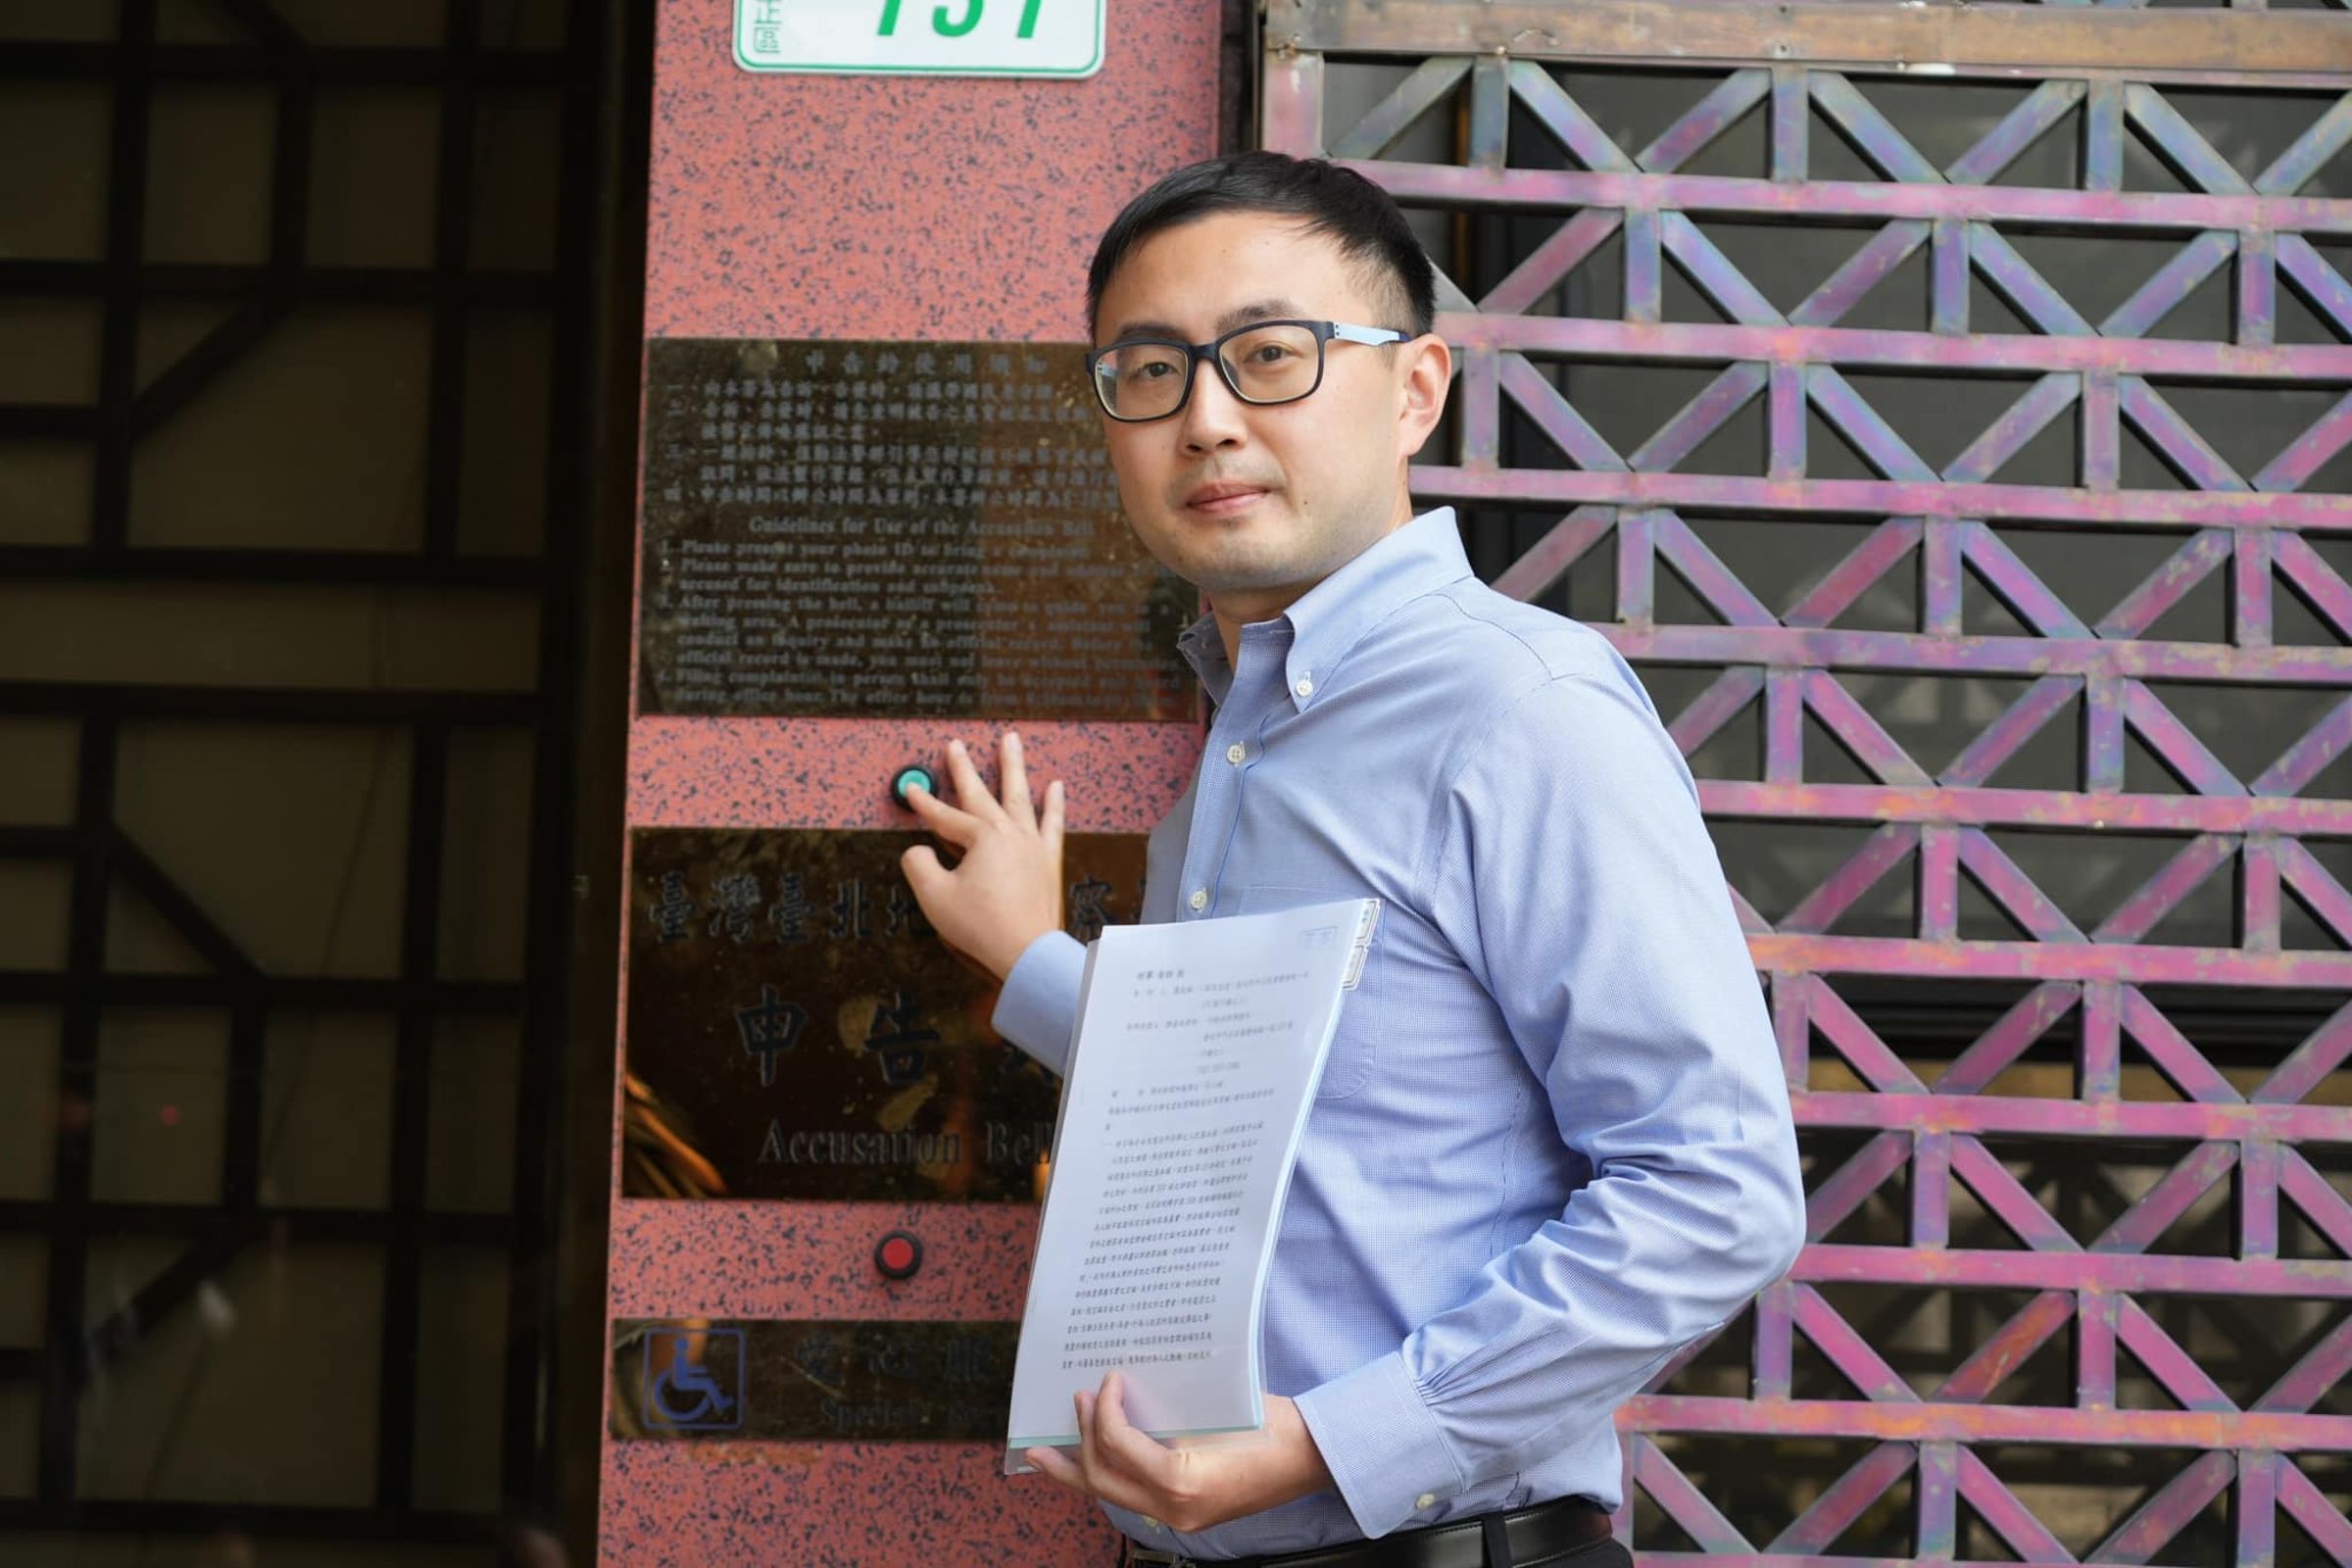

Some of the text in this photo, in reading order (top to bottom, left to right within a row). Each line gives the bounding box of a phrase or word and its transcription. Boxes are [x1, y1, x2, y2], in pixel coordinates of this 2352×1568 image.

[749, 515, 834, 533] Guidelines
[842, 515, 866, 533] for
[874, 516, 903, 533] Use
[933, 515, 959, 535] the
[681, 539, 730, 555] Please
[680, 558, 730, 574] Please
[756, 1116, 963, 1166] Accusation
